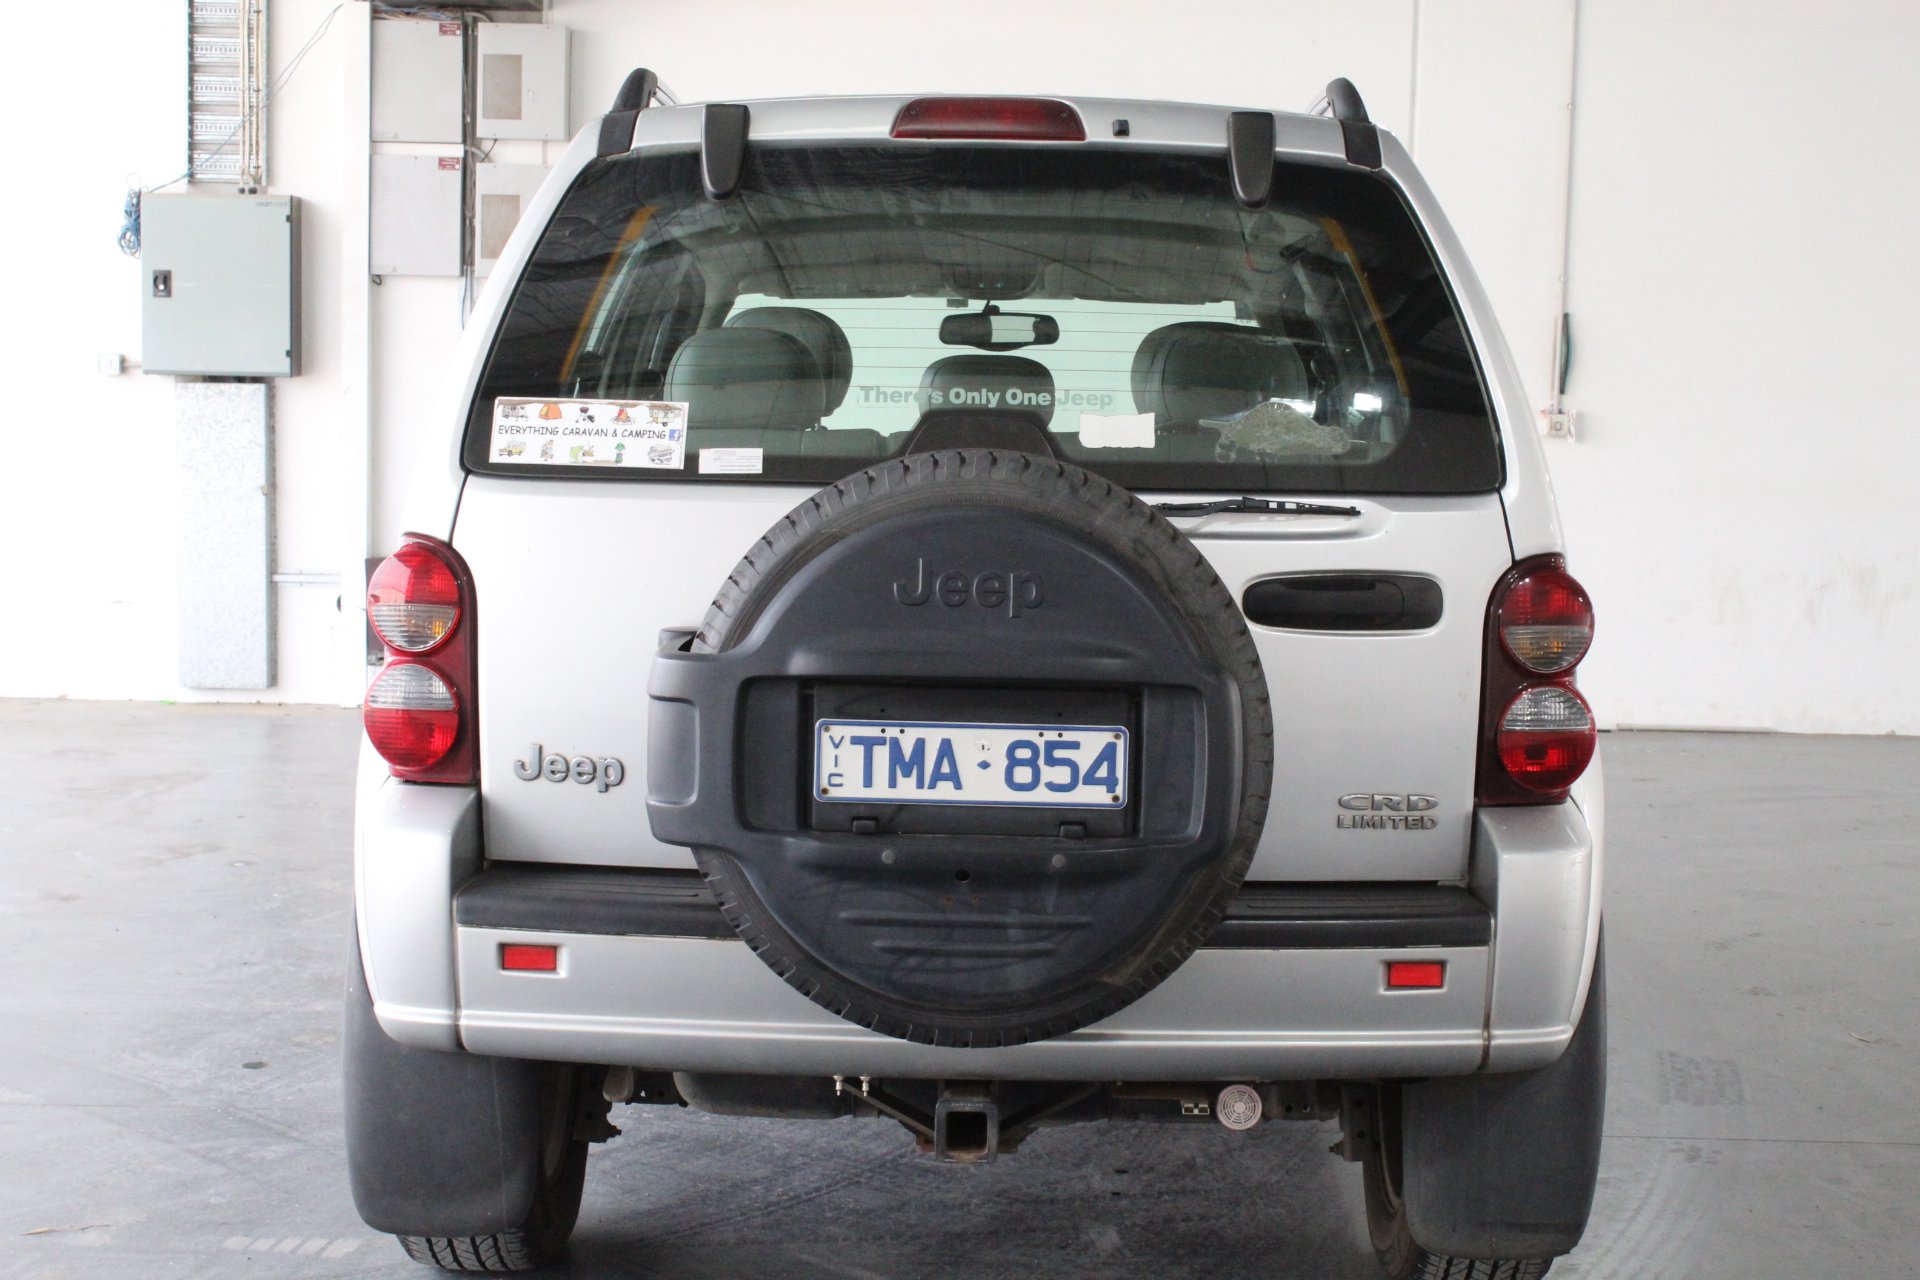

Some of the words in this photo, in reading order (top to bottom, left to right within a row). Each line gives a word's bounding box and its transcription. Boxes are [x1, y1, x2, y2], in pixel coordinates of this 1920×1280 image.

[949, 387, 1000, 408] Only
[1005, 388, 1052, 406] One
[1057, 389, 1113, 410] Jeep
[498, 425, 559, 436] EVERYTHING
[562, 427, 608, 437] CARAVAN
[612, 428, 618, 438] &
[621, 428, 667, 440] CAMPING
[893, 557, 1044, 618] Jeep
[513, 743, 625, 793] Jeep
[827, 735, 844, 787] VIC
[849, 735, 963, 790] TMA
[1004, 739, 1119, 794] 854
[1338, 793, 1439, 812] CRD
[1337, 814, 1439, 830] LIMITED
